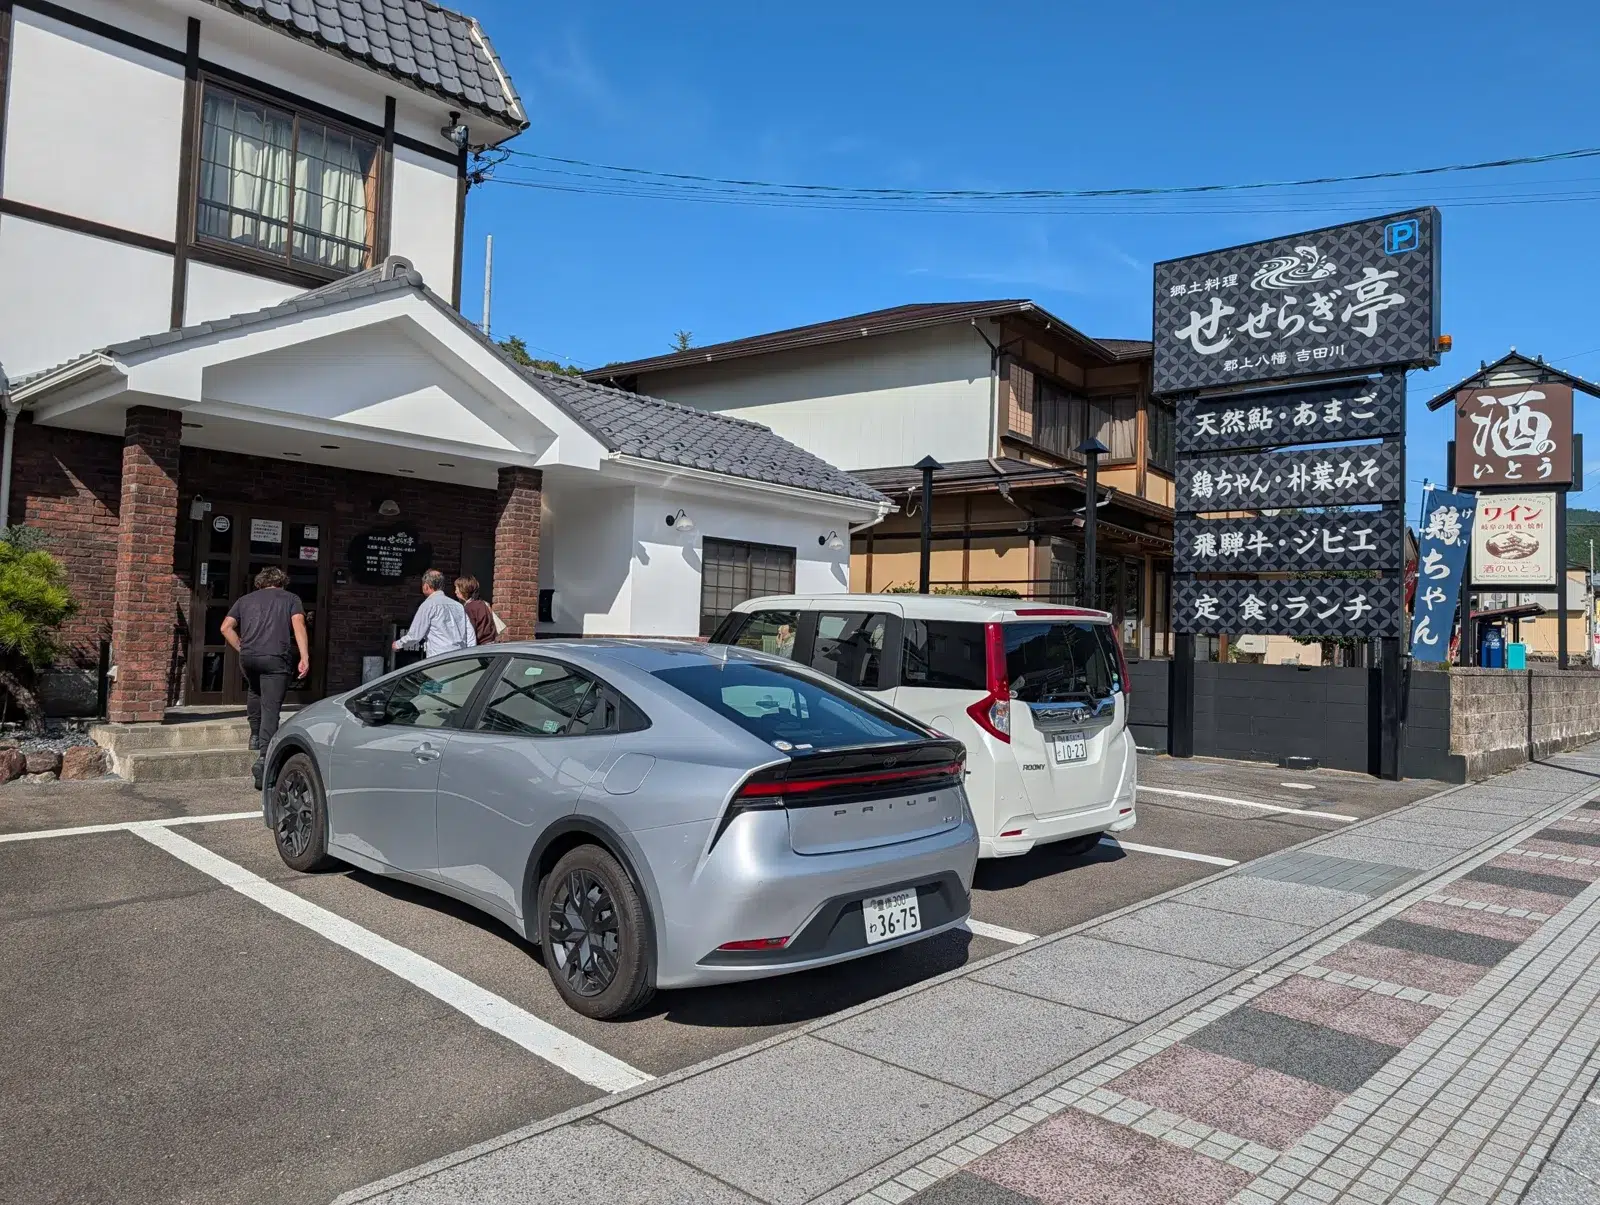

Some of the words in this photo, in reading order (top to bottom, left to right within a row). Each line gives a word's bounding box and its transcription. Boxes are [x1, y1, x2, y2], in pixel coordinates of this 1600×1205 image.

[1392, 223, 1413, 251] P
[1169, 273, 1239, 298] 郷土料理
[1174, 267, 1406, 355] せせらぎ亭
[1223, 350, 1287, 372] 郡上八幡
[1295, 344, 1346, 363] 吉田川
[1193, 392, 1378, 437] 天然鮎・あまご
[1469, 390, 1557, 458] 酒の
[1191, 458, 1380, 499] 鶏ちゃん・朴葉みそ
[1473, 457, 1553, 480] いとう
[1484, 504, 1543, 522] ワイン
[1192, 526, 1377, 558] 飛騨牛・ジビエ
[1413, 505, 1462, 646] 鶏ちゃん
[1483, 564, 1542, 574] 酒のいとう
[1062, 743, 1085, 759] 10-23
[1022, 763, 1046, 771] ROOMY
[833, 796, 937, 817] PRIUS
[893, 893, 906, 908] 300
[869, 922, 877, 933] わ
[877, 906, 918, 937] 36-75
